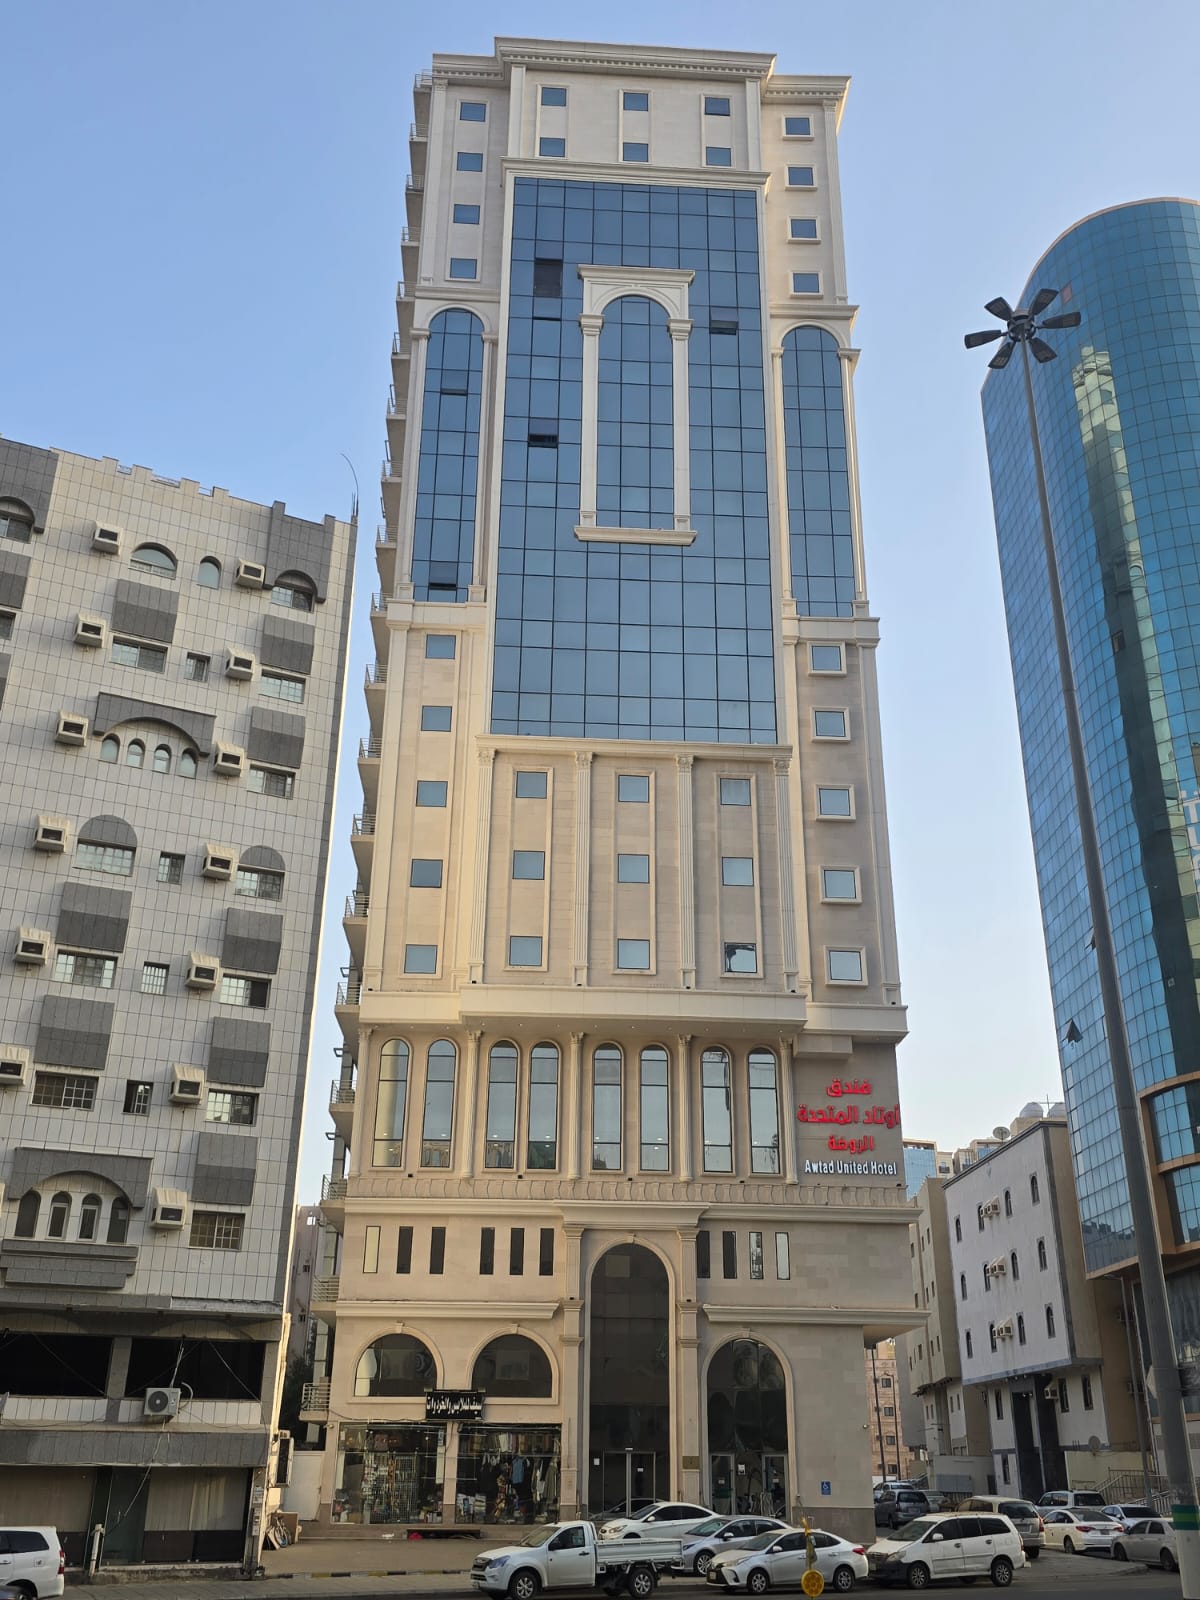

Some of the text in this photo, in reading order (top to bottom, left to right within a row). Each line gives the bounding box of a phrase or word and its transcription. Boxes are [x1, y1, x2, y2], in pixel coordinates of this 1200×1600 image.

[826, 1078, 872, 1097] فندق
[797, 1104, 859, 1124] المتحدة
[828, 1134, 875, 1154] الروضة
[804, 1159, 897, 1175] Awtad United Hotel
